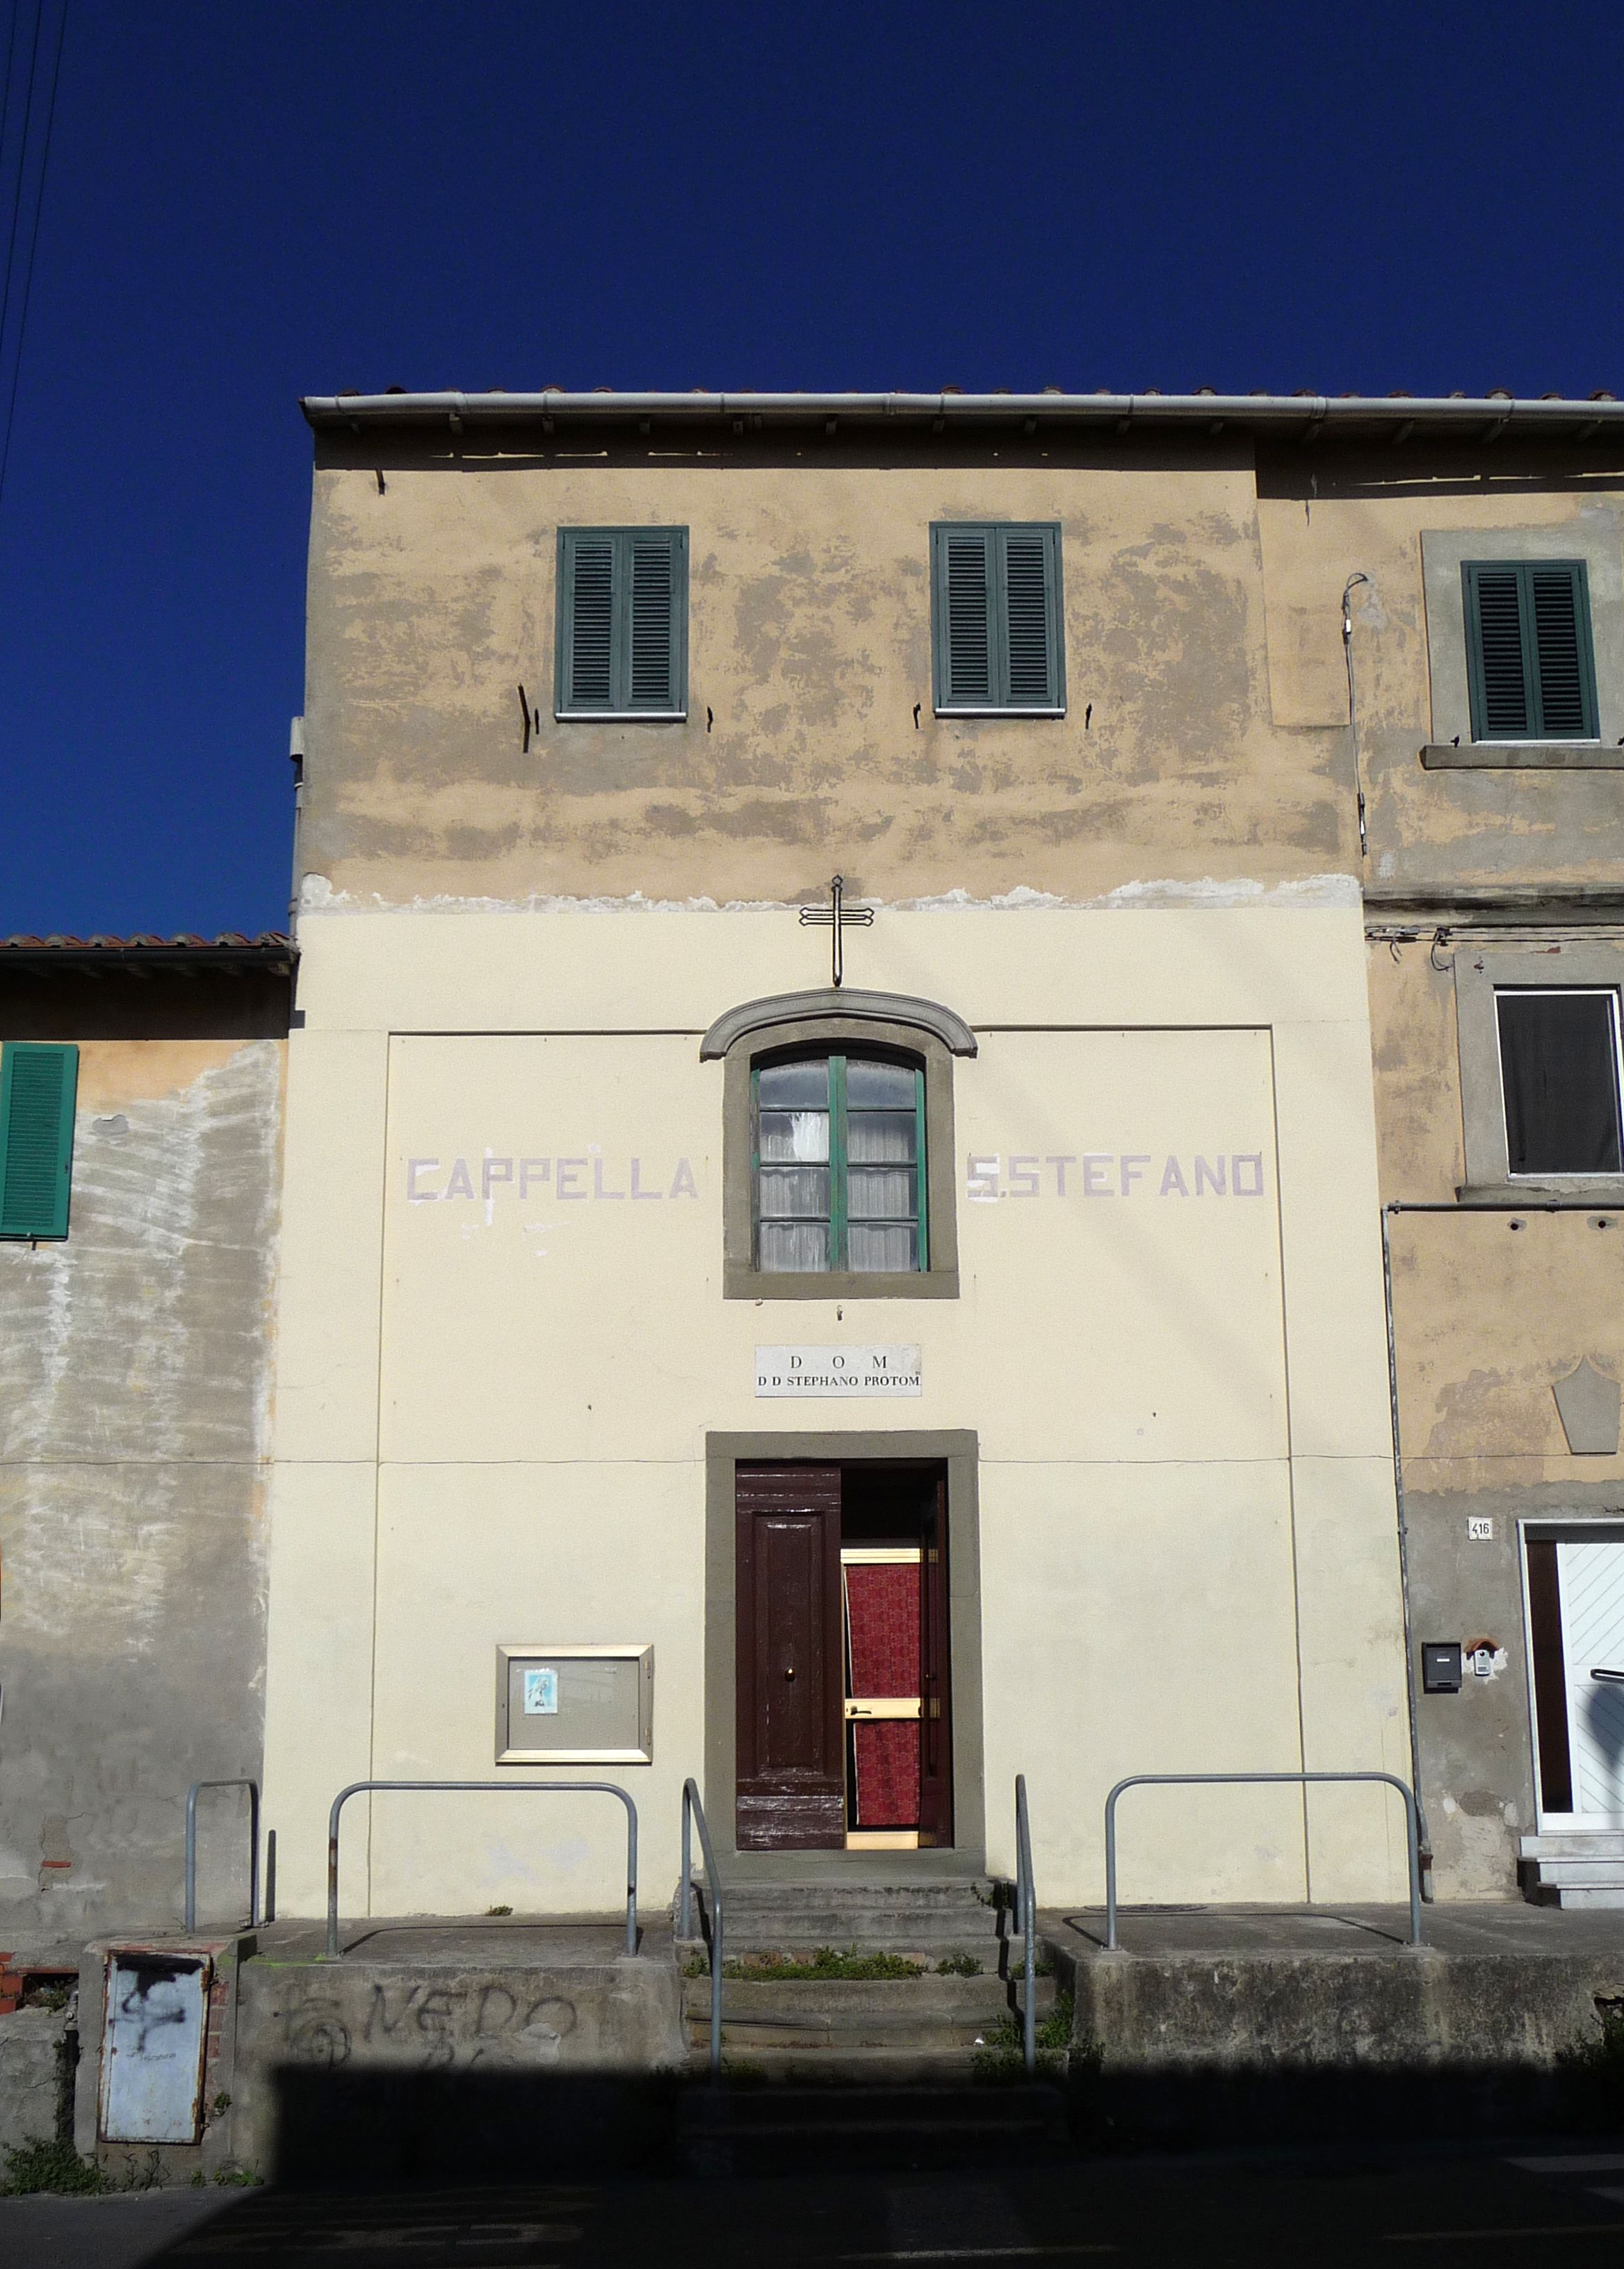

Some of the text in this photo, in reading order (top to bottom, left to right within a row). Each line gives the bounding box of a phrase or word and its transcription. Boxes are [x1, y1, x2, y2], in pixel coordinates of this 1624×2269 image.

[407, 1157, 699, 1201] CAPPELLA
[790, 1356, 886, 1369] D O M
[758, 1376, 767, 1386] D
[772, 1376, 781, 1386] D
[787, 1376, 858, 1386] STEPHANO
[1472, 1523, 1489, 1534] 416
